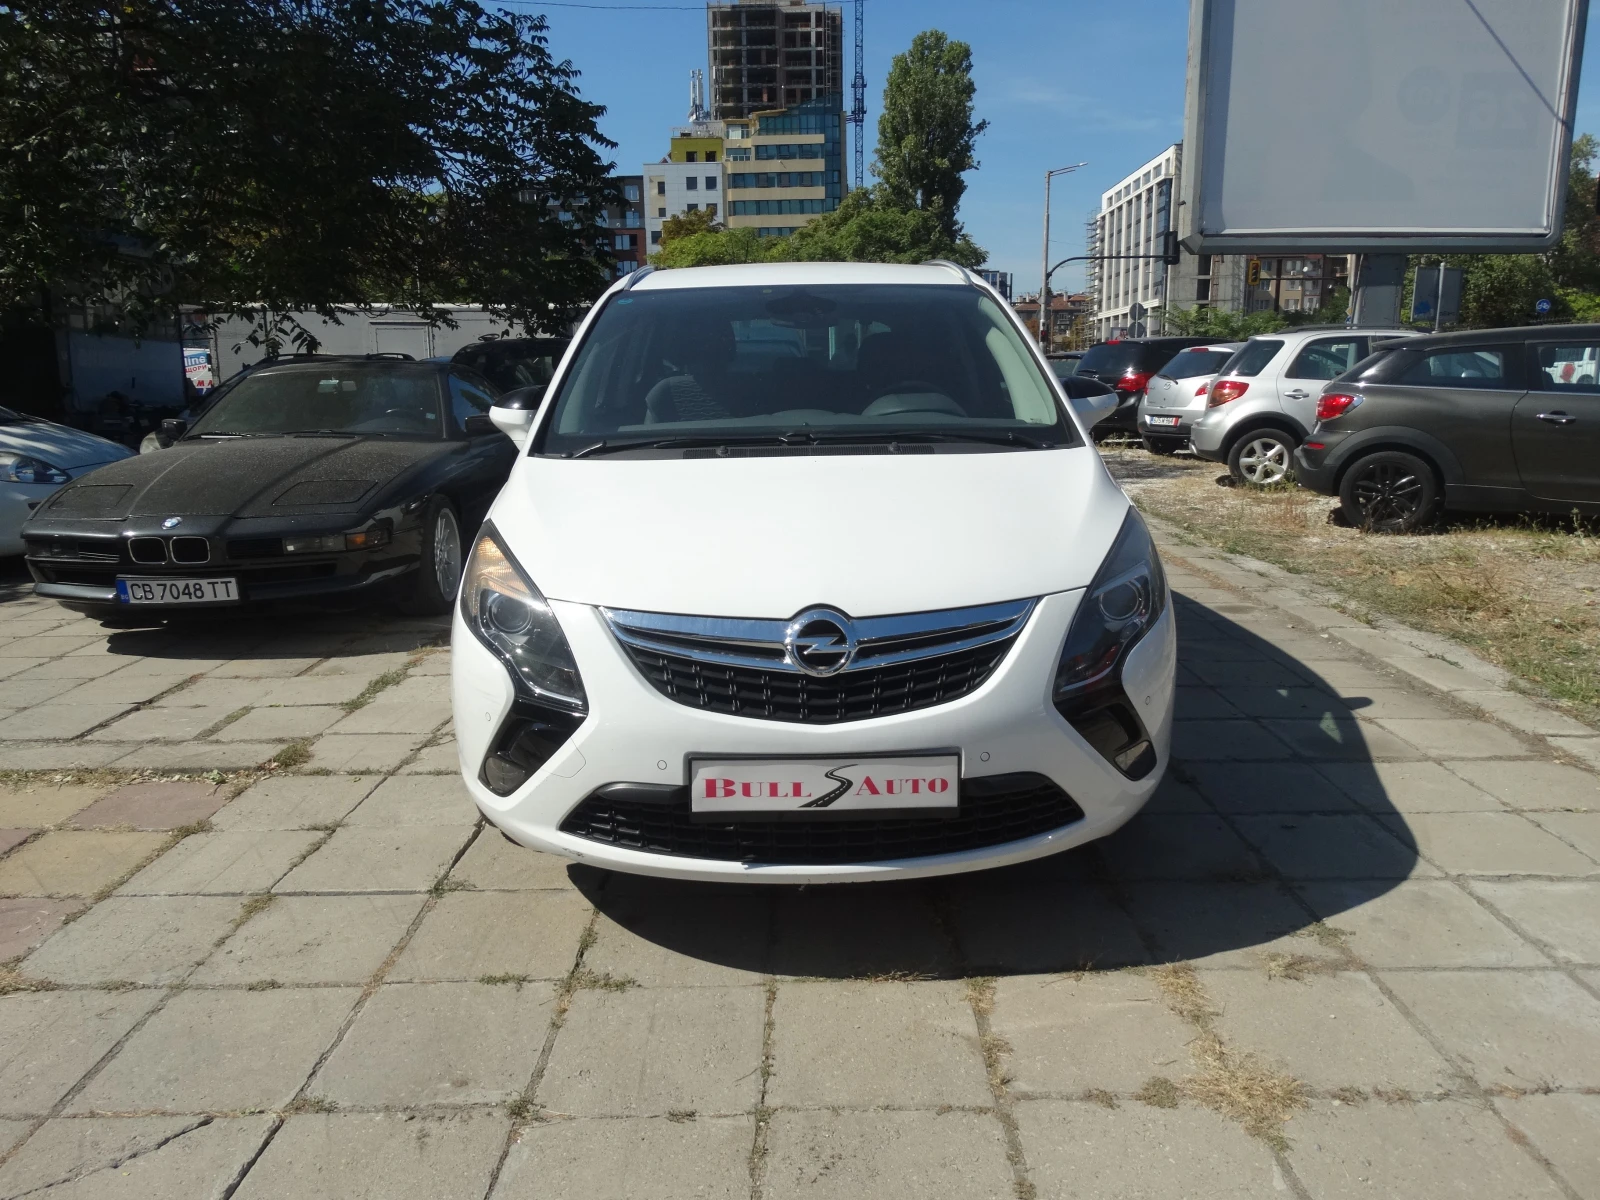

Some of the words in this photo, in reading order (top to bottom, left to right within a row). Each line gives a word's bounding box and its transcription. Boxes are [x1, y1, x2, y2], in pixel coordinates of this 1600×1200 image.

[130, 583, 155, 601] CB
[156, 583, 205, 601] 7048
[206, 581, 233, 599] TT
[702, 777, 812, 799] BULL
[853, 775, 950, 796] AUTO
